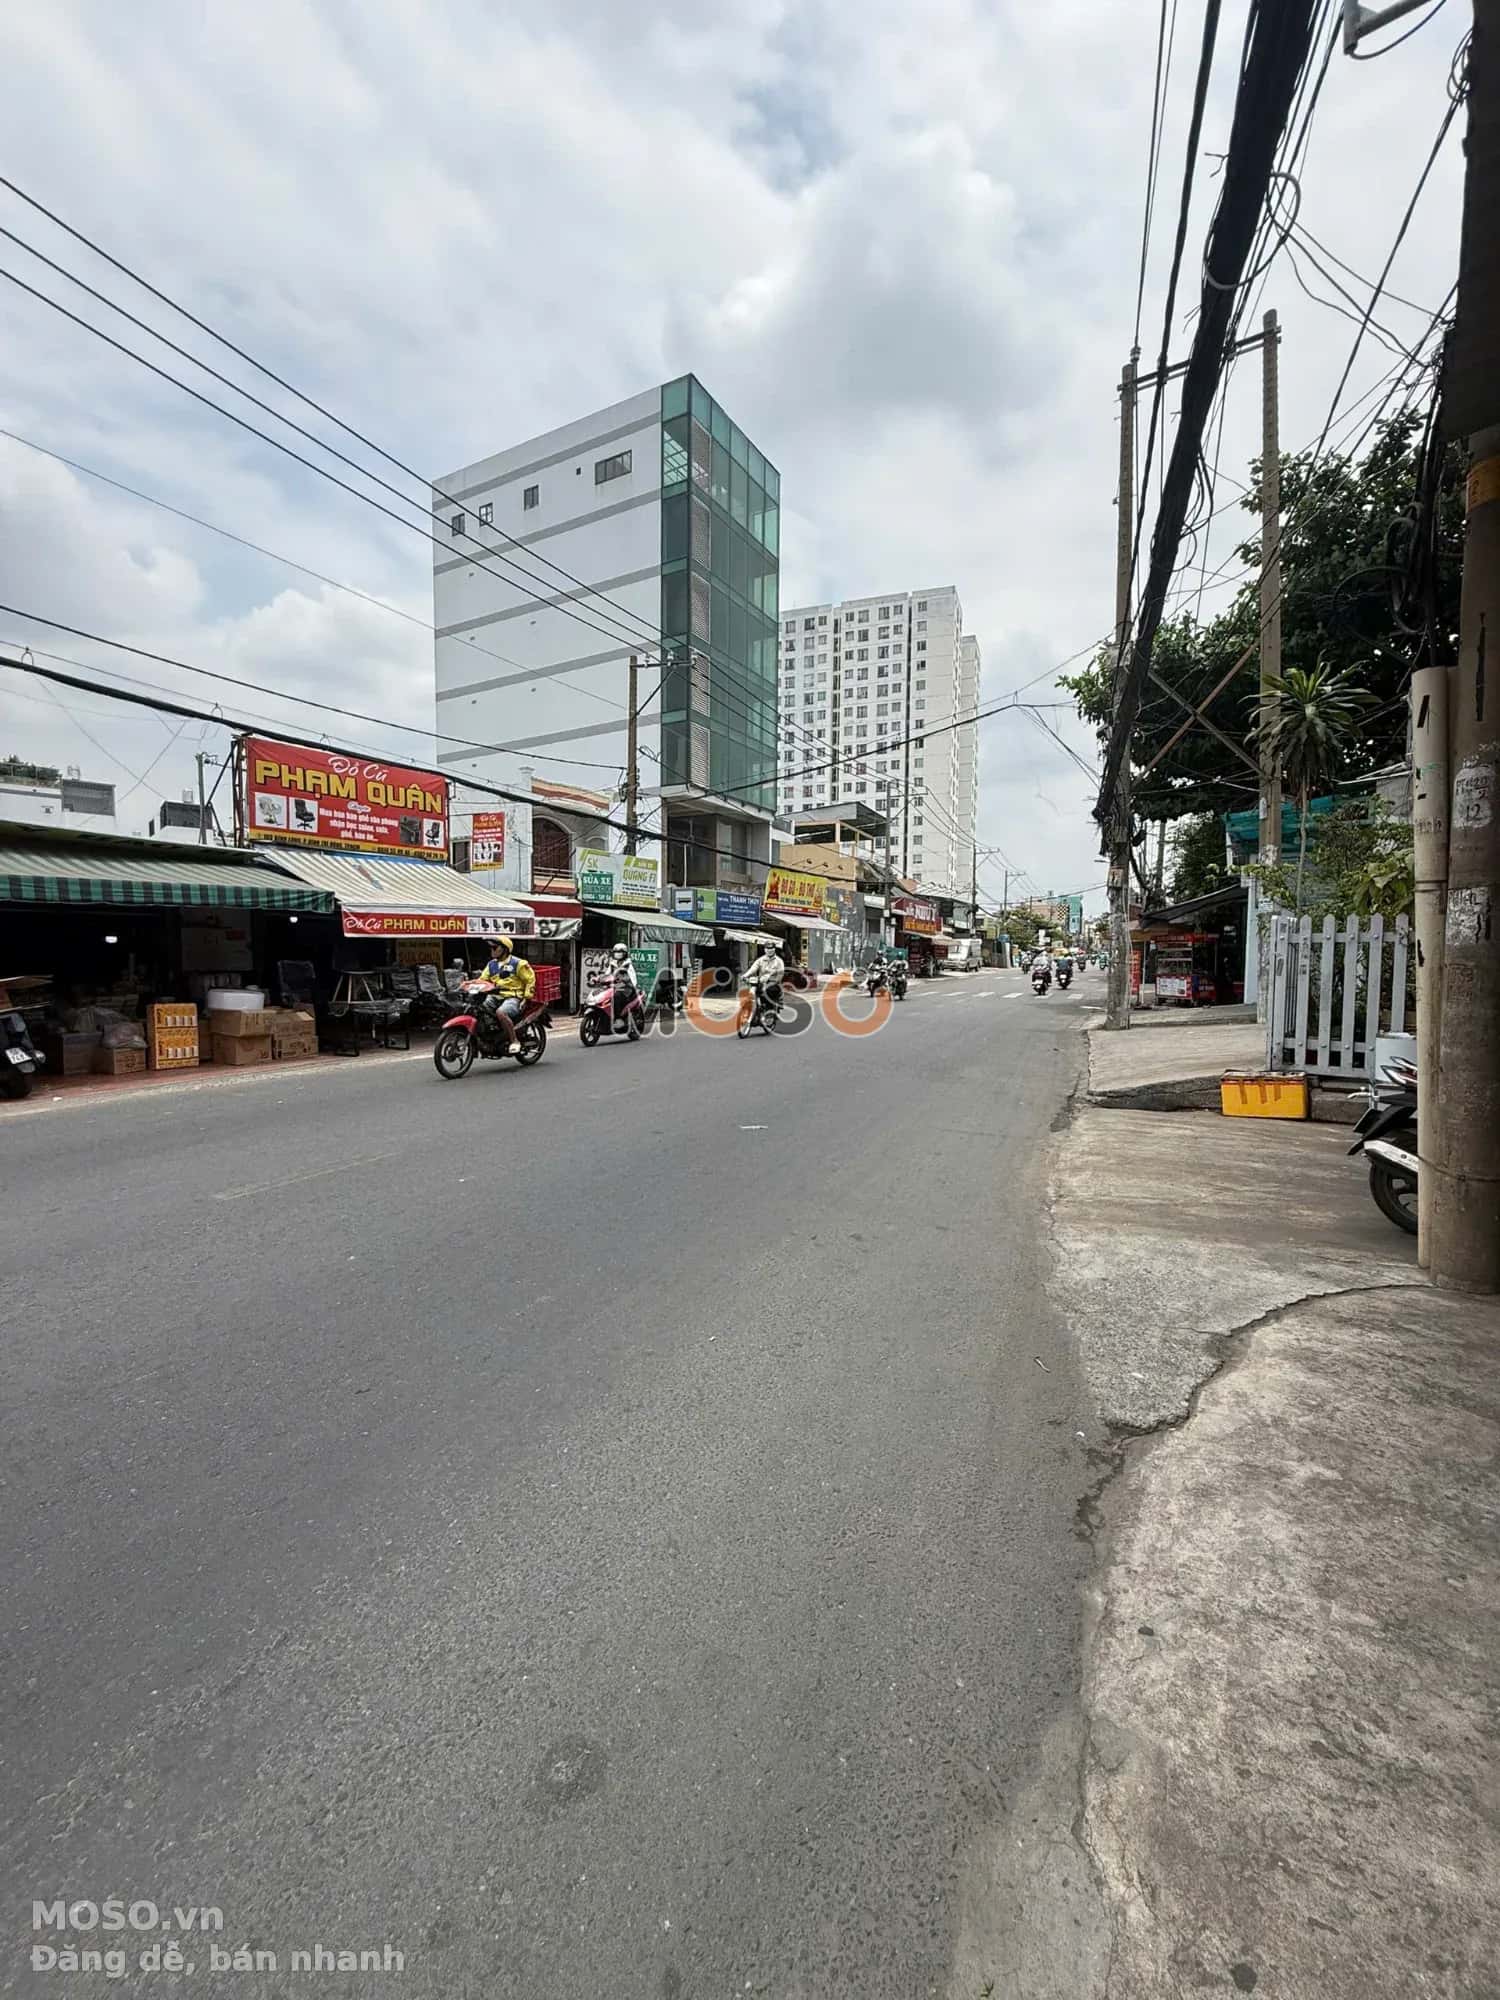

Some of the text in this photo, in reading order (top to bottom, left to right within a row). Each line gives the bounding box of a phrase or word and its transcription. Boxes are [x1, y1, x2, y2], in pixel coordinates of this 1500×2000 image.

[254, 759, 443, 815] PHẠM QUÂN
[383, 917, 425, 933] PHẠM
[429, 916, 466, 931] QUÂN
